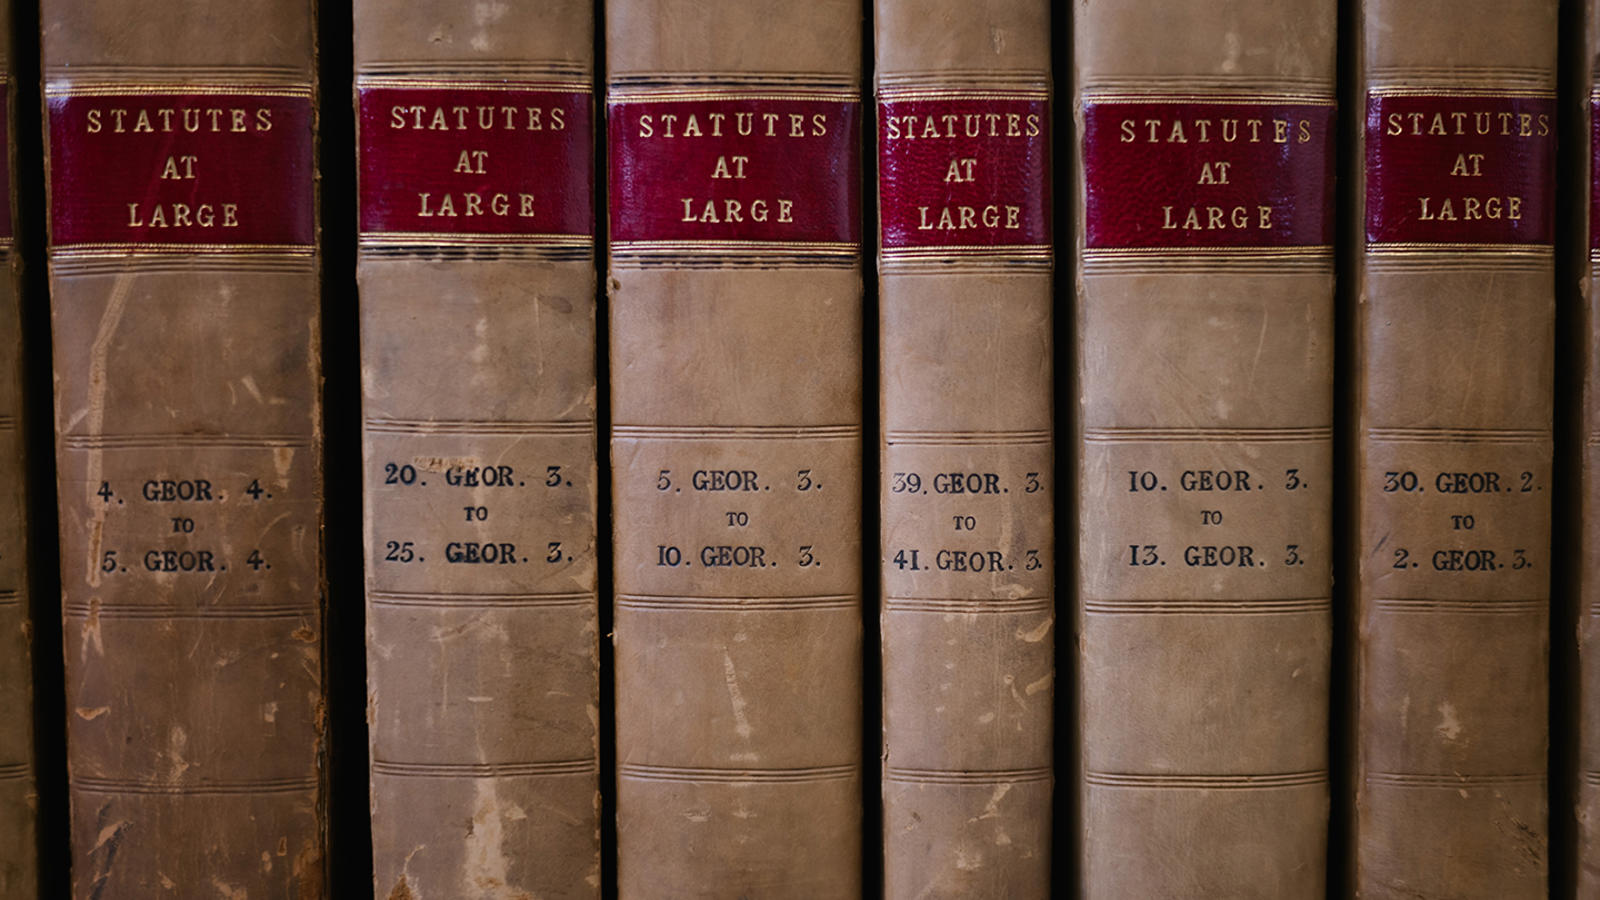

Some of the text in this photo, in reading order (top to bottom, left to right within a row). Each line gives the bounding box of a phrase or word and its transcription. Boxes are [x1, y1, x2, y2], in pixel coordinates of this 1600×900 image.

[88, 109, 272, 132] STATUTES
[391, 106, 564, 130] STATUTES
[640, 113, 826, 137] STATUTES
[887, 114, 1039, 139] STATUTES
[1387, 112, 1548, 136] STATUTES
[1121, 120, 1310, 143] STATUTES
[161, 156, 197, 179] AT
[454, 151, 488, 174] AT
[712, 156, 748, 178] AT
[944, 159, 976, 182] AT
[1198, 162, 1230, 184] AT
[1451, 154, 1484, 176] AT
[129, 204, 238, 227] LARGE
[418, 193, 534, 216] LARGE
[682, 198, 792, 223] LARGE
[1419, 197, 1521, 220] LARGE
[918, 205, 1019, 230] LARGE
[1162, 206, 1271, 230] LARGE
[384, 462, 427, 486] 20.
[545, 465, 573, 487] 3.
[656, 469, 822, 493] 5. GEOR. 3.
[892, 472, 1045, 495] 39. GEOR. 3.
[1180, 470, 1264, 492] GEOR.
[1285, 468, 1308, 490] 3.
[1383, 470, 1543, 494] 30. GEOR. 2.
[97, 478, 273, 505] 4. GEOR. 4.
[171, 516, 195, 534] TO
[463, 506, 489, 522] TO
[725, 511, 749, 527] TO
[952, 515, 977, 531] TO
[1200, 510, 1223, 525] TO
[1450, 514, 1475, 530] TO
[101, 549, 272, 573] 5. GEOR. 4.
[385, 540, 573, 565] 25. GEOR. 3.
[700, 545, 777, 568] GEOR.
[798, 545, 821, 567] 3.
[936, 549, 1014, 573] GEOR.
[1025, 549, 1043, 571] 3.
[1184, 545, 1265, 568] GEOR.
[1284, 544, 1305, 566] 3.
[1392, 548, 1533, 571] 2. GEOR. 3.
